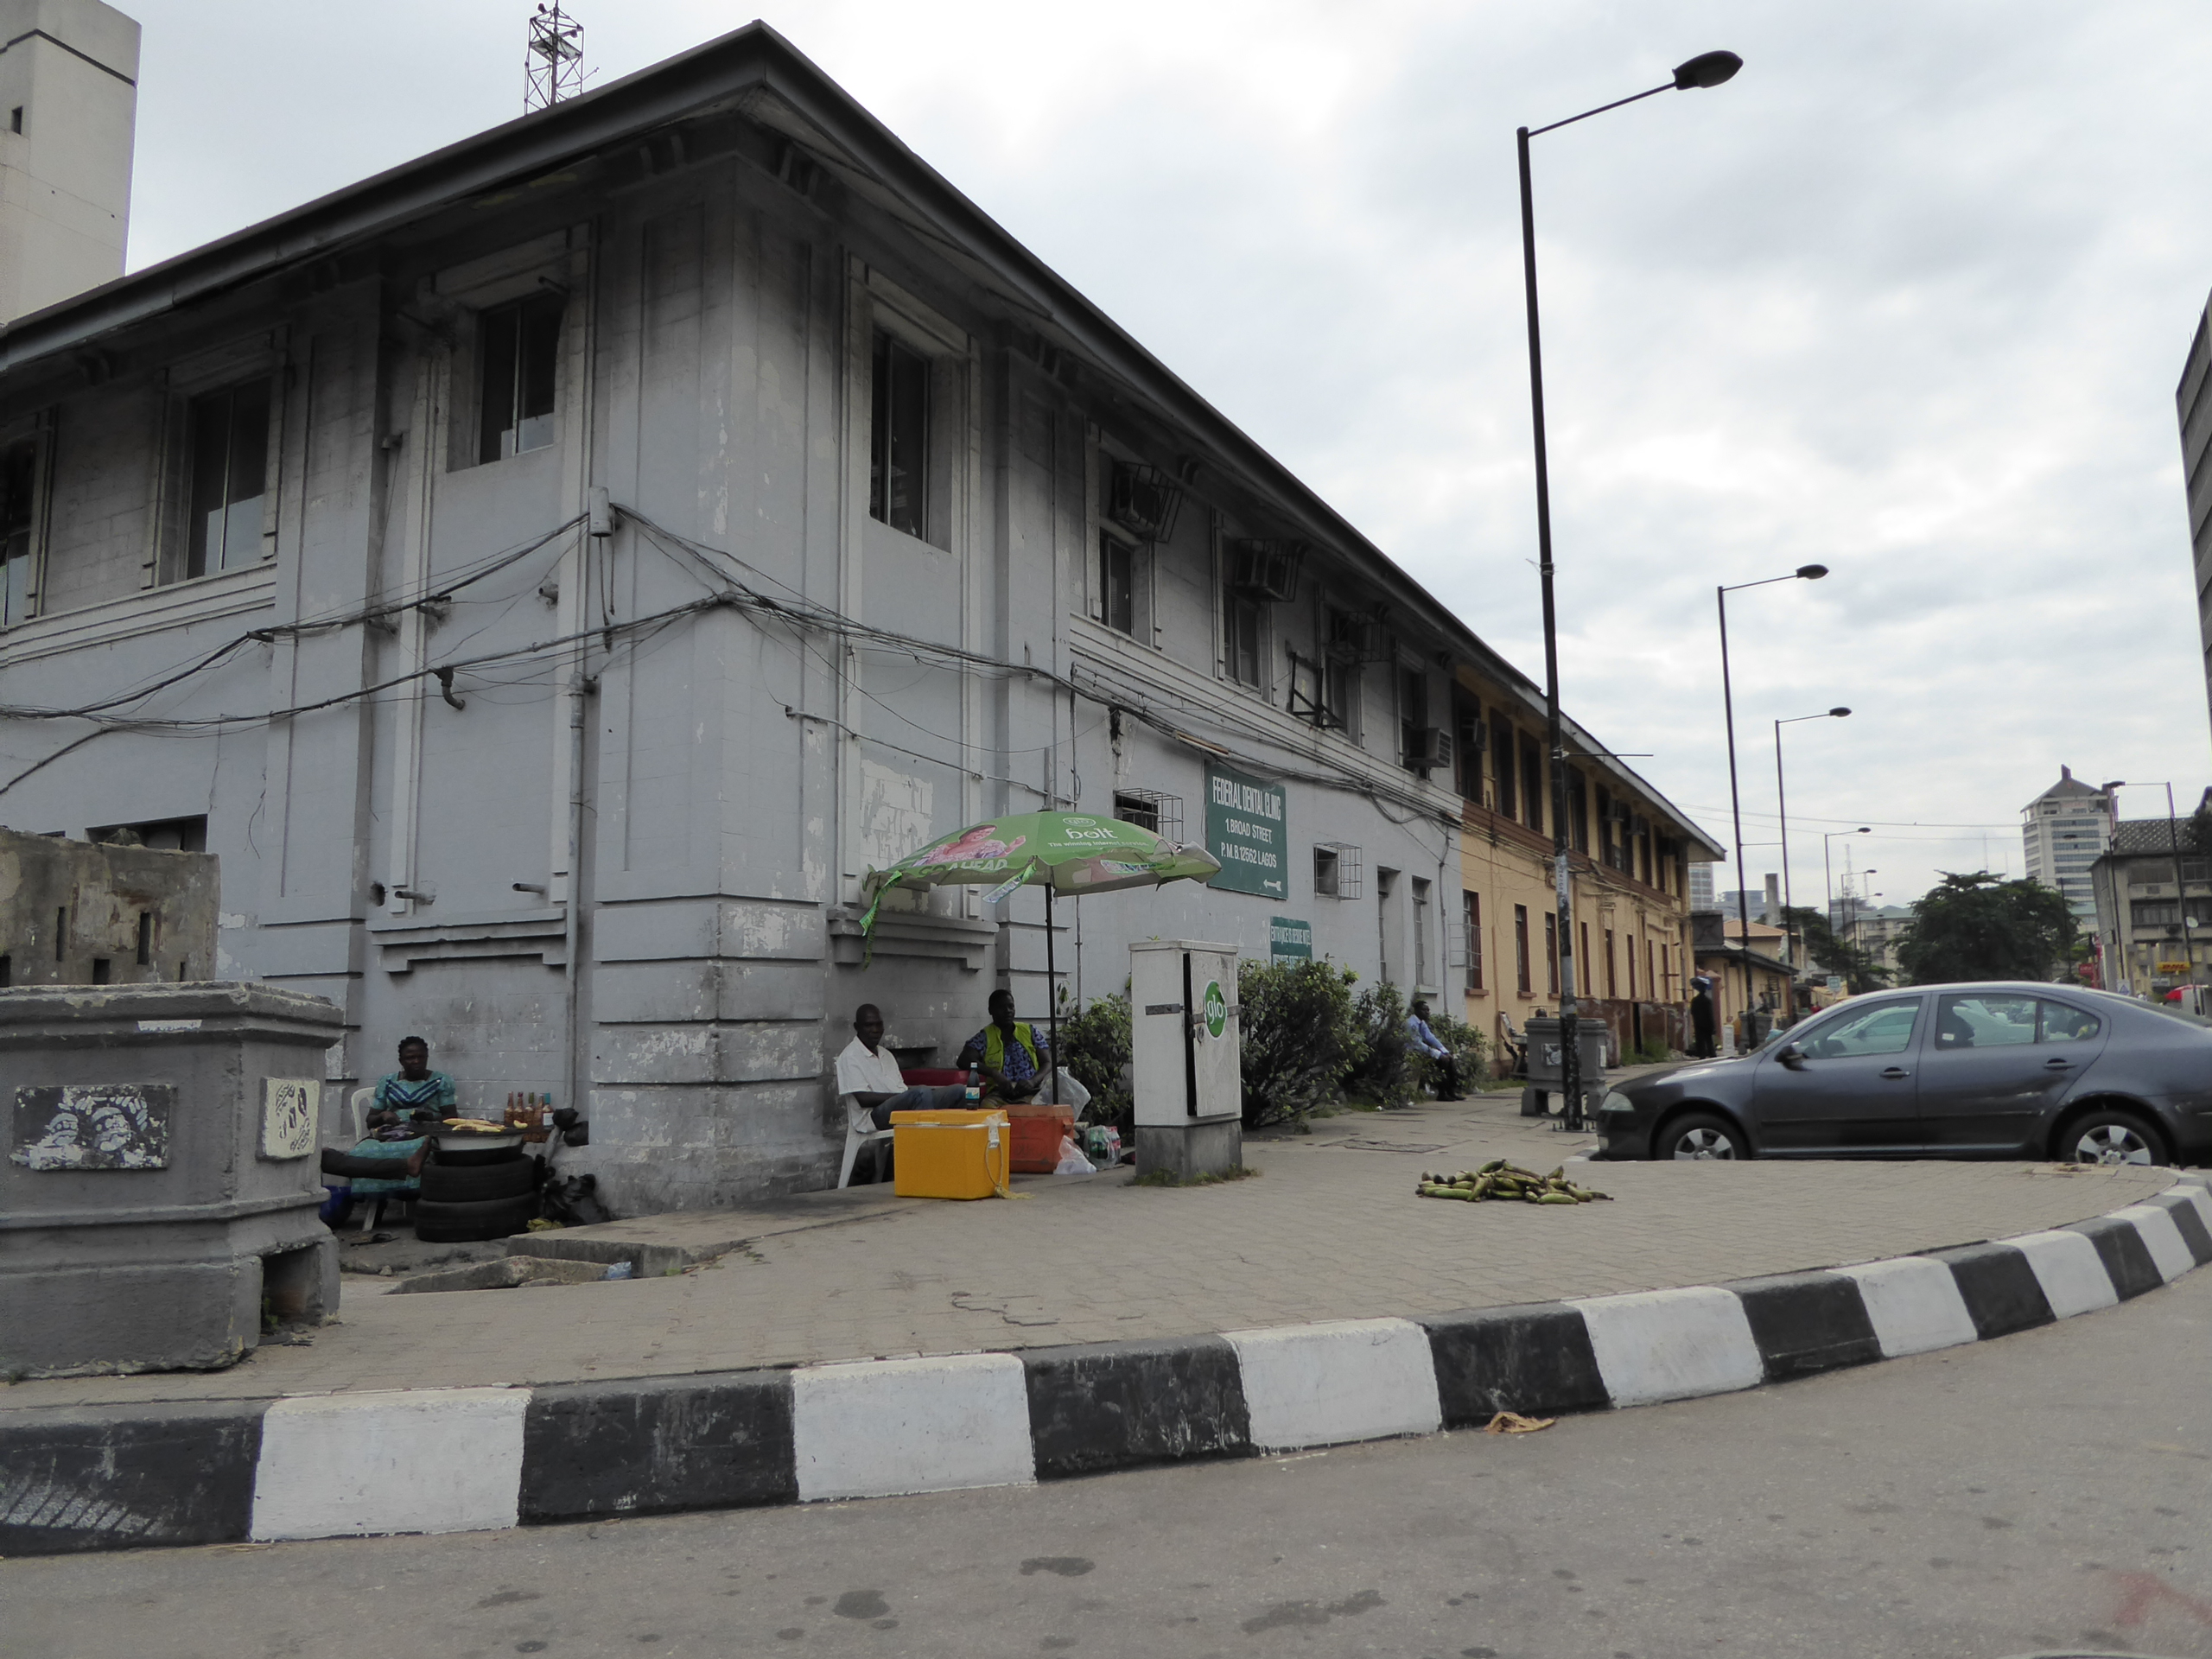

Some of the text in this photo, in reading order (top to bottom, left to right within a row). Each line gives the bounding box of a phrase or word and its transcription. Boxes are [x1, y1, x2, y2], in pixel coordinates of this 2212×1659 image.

[1212, 776, 1281, 821] FEDERAL DENTAL CLINIC
[1065, 828, 1119, 839] bolt
[948, 859, 1007, 871] AHEAD
[1257, 850, 1277, 868] LAGOS
[1206, 994, 1224, 1025] glo
